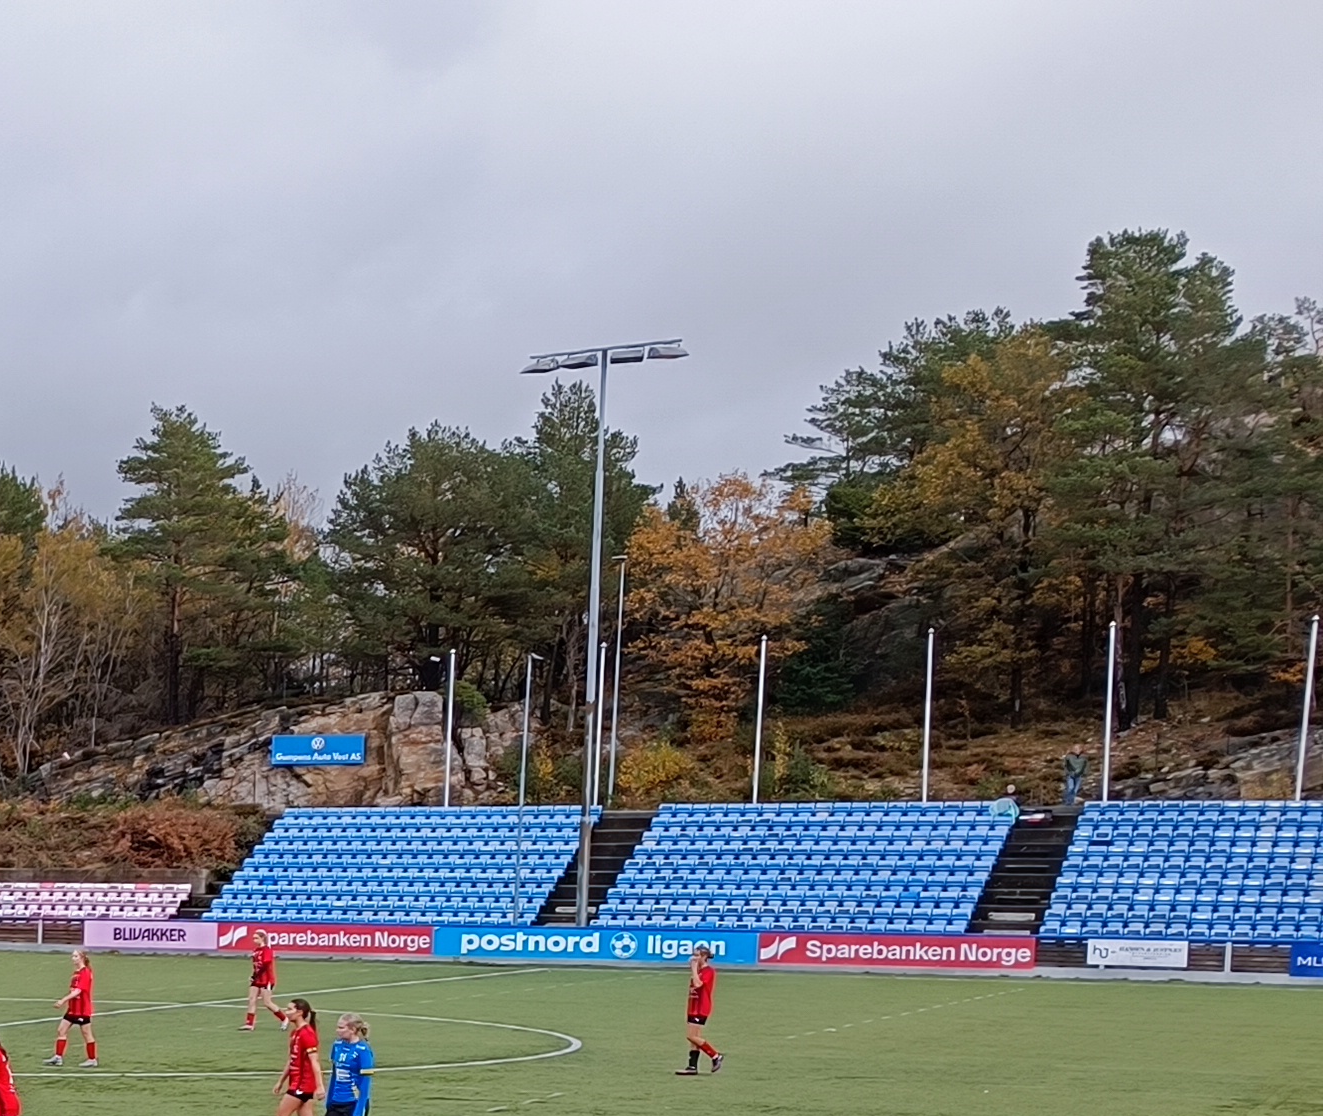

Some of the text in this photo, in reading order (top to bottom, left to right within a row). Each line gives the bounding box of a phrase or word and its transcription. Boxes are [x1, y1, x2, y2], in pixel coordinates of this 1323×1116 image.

[313, 753, 331, 761] Auto
[333, 753, 348, 761] Vest
[114, 927, 187, 941] BLIVAKKER
[375, 933, 431, 951] Norge
[460, 932, 600, 953] postnord
[805, 940, 1032, 966] Sparebanken Norge
